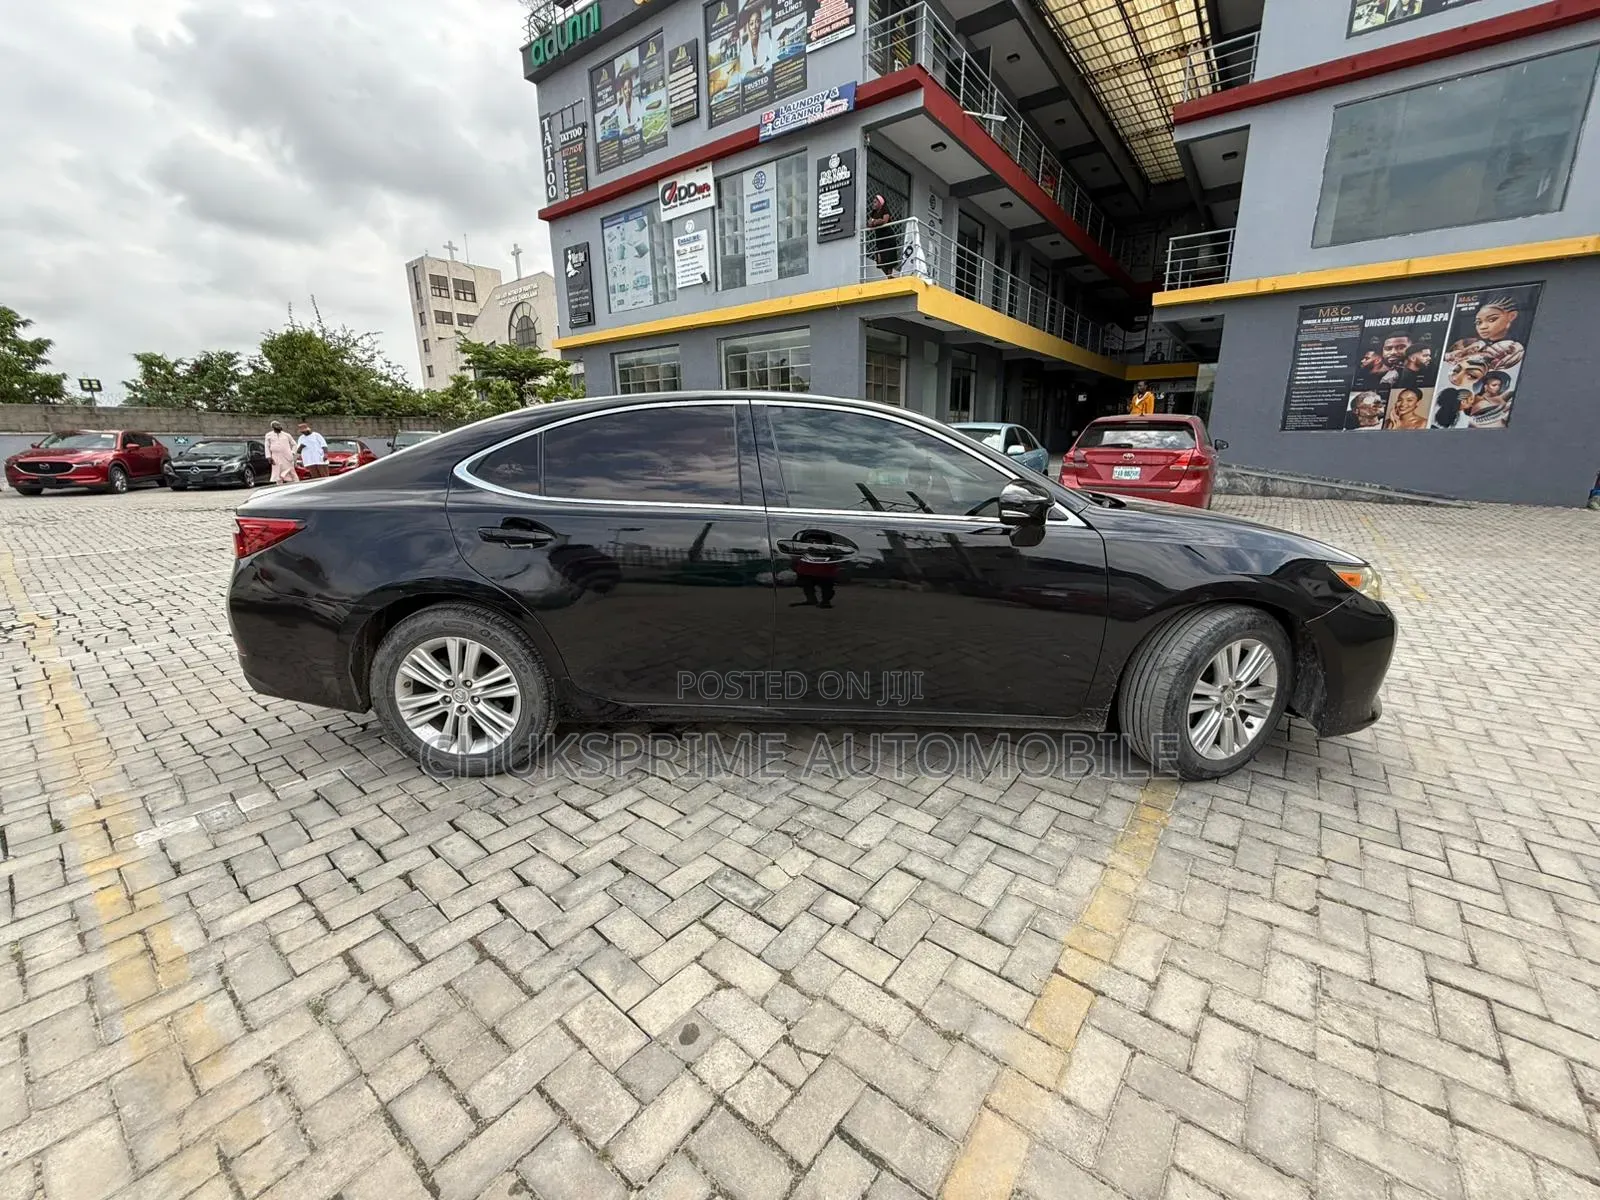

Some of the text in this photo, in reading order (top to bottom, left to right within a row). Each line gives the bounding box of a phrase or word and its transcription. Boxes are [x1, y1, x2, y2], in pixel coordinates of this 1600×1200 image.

[744, 76, 768, 91] TRUSTED
[780, 91, 828, 115] LAUNDRY
[830, 87, 839, 98] &
[774, 105, 822, 128] CLEANING
[560, 127, 582, 142] TATTOO
[541, 117, 557, 198] TATTOO
[1319, 306, 1351, 318] M&C
[1392, 302, 1426, 314] M&C
[1364, 312, 1449, 328] UNISEX SALON AND SPA
